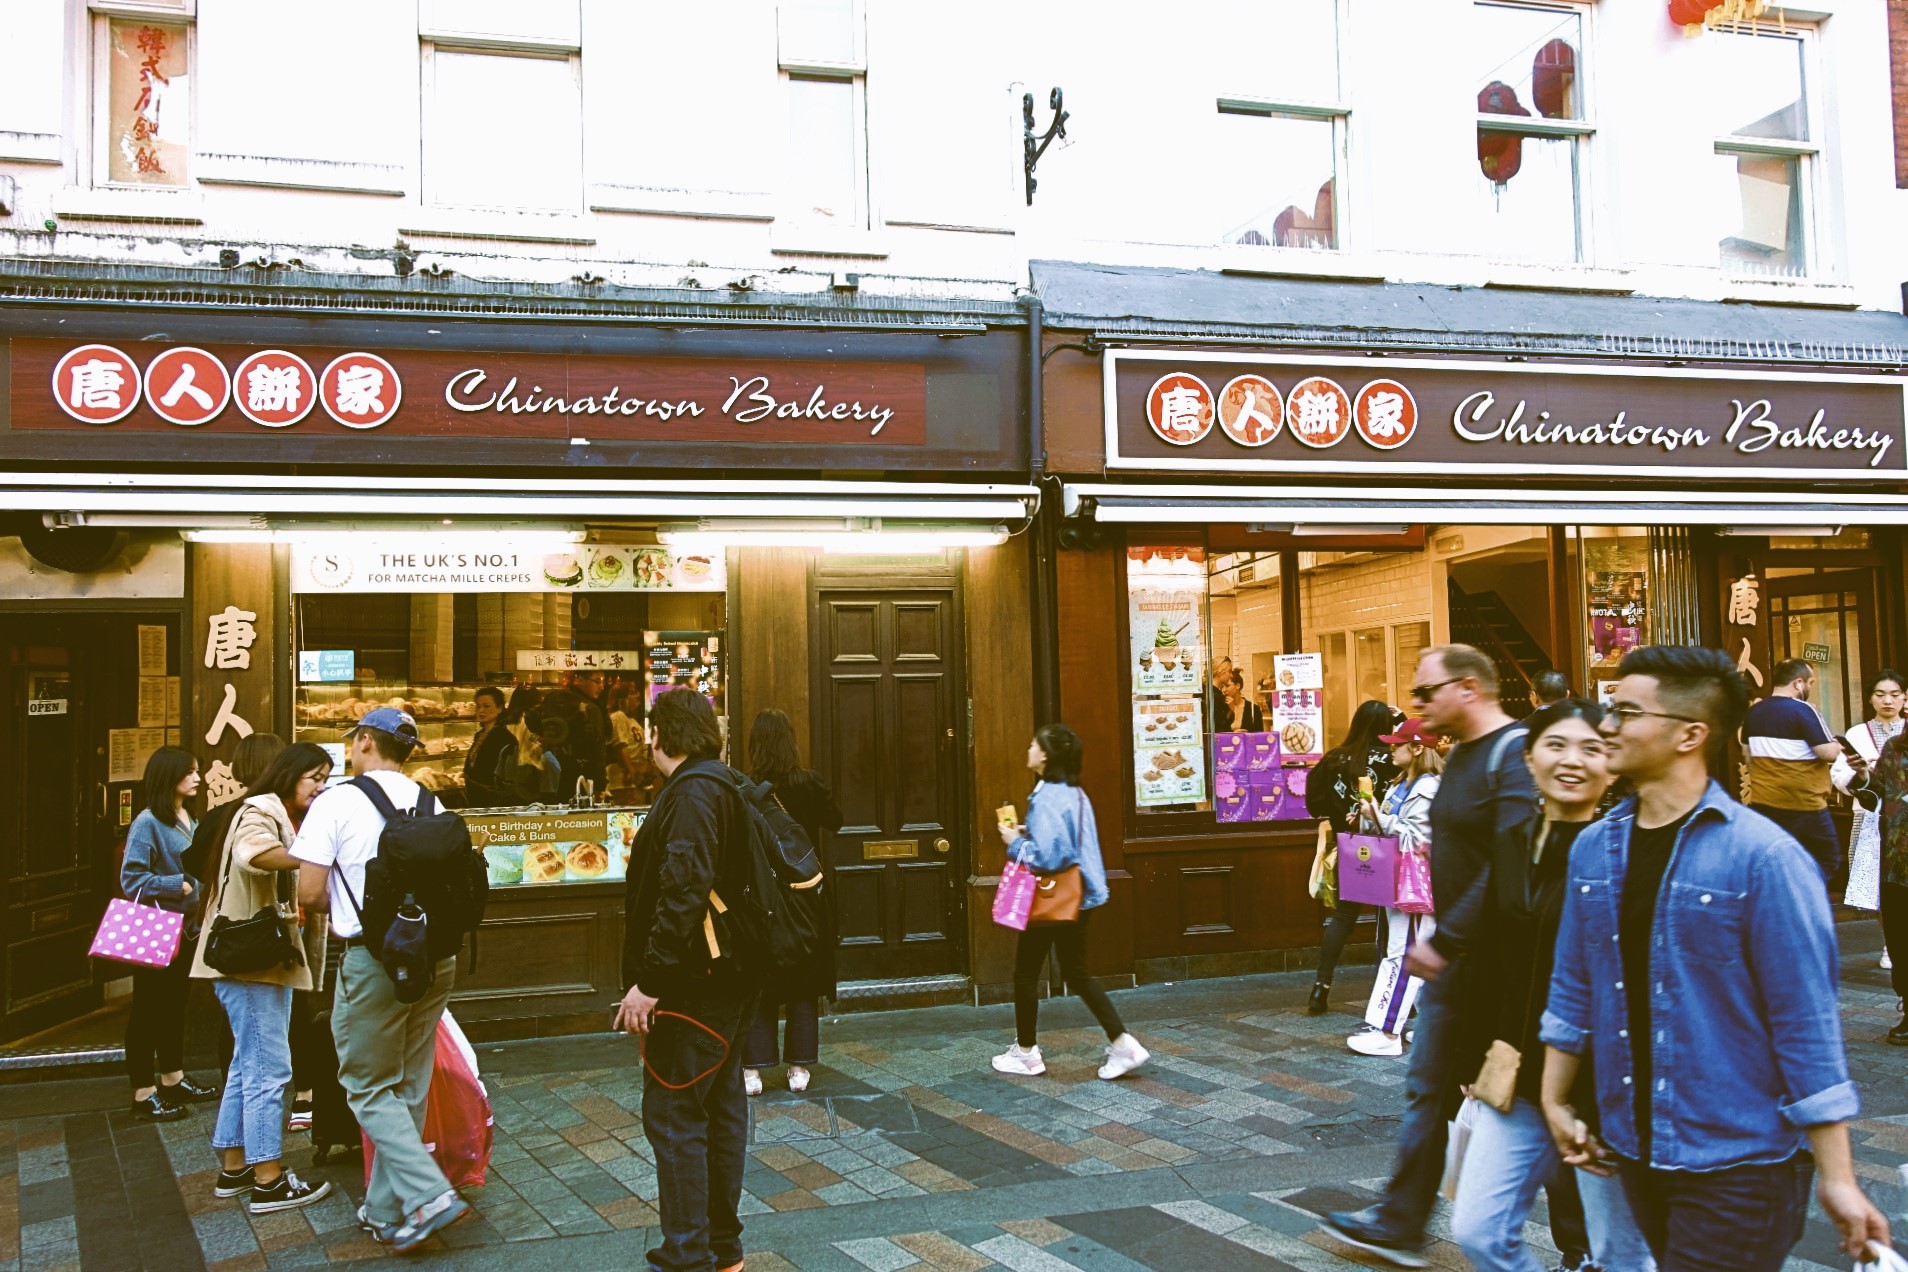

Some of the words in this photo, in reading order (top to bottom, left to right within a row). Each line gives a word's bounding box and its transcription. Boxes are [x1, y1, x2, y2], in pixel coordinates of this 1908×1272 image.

[70, 359, 385, 416] 唐人餅家
[445, 368, 705, 421] Chinatown
[721, 377, 895, 435] Bakery
[1161, 387, 1405, 438] 唐人餅家
[1453, 391, 1711, 451] Chinatown
[1726, 400, 1894, 466] Bakery
[380, 554, 416, 567] THE
[424, 554, 467, 567] UK'S
[474, 554, 518, 567] NO.1
[368, 573, 391, 583] FOR
[395, 573, 446, 583] MATCHA
[450, 573, 485, 583] MILLE
[488, 573, 531, 583] CREPES
[1805, 650, 1827, 661] OPEN
[30, 702, 59, 713] OPEN
[467, 823, 488, 834] ding
[499, 821, 543, 832] Birthday
[554, 819, 603, 829] Occasion
[489, 833, 517, 842] Cake
[518, 832, 527, 840] &
[529, 832, 556, 840] Buns
